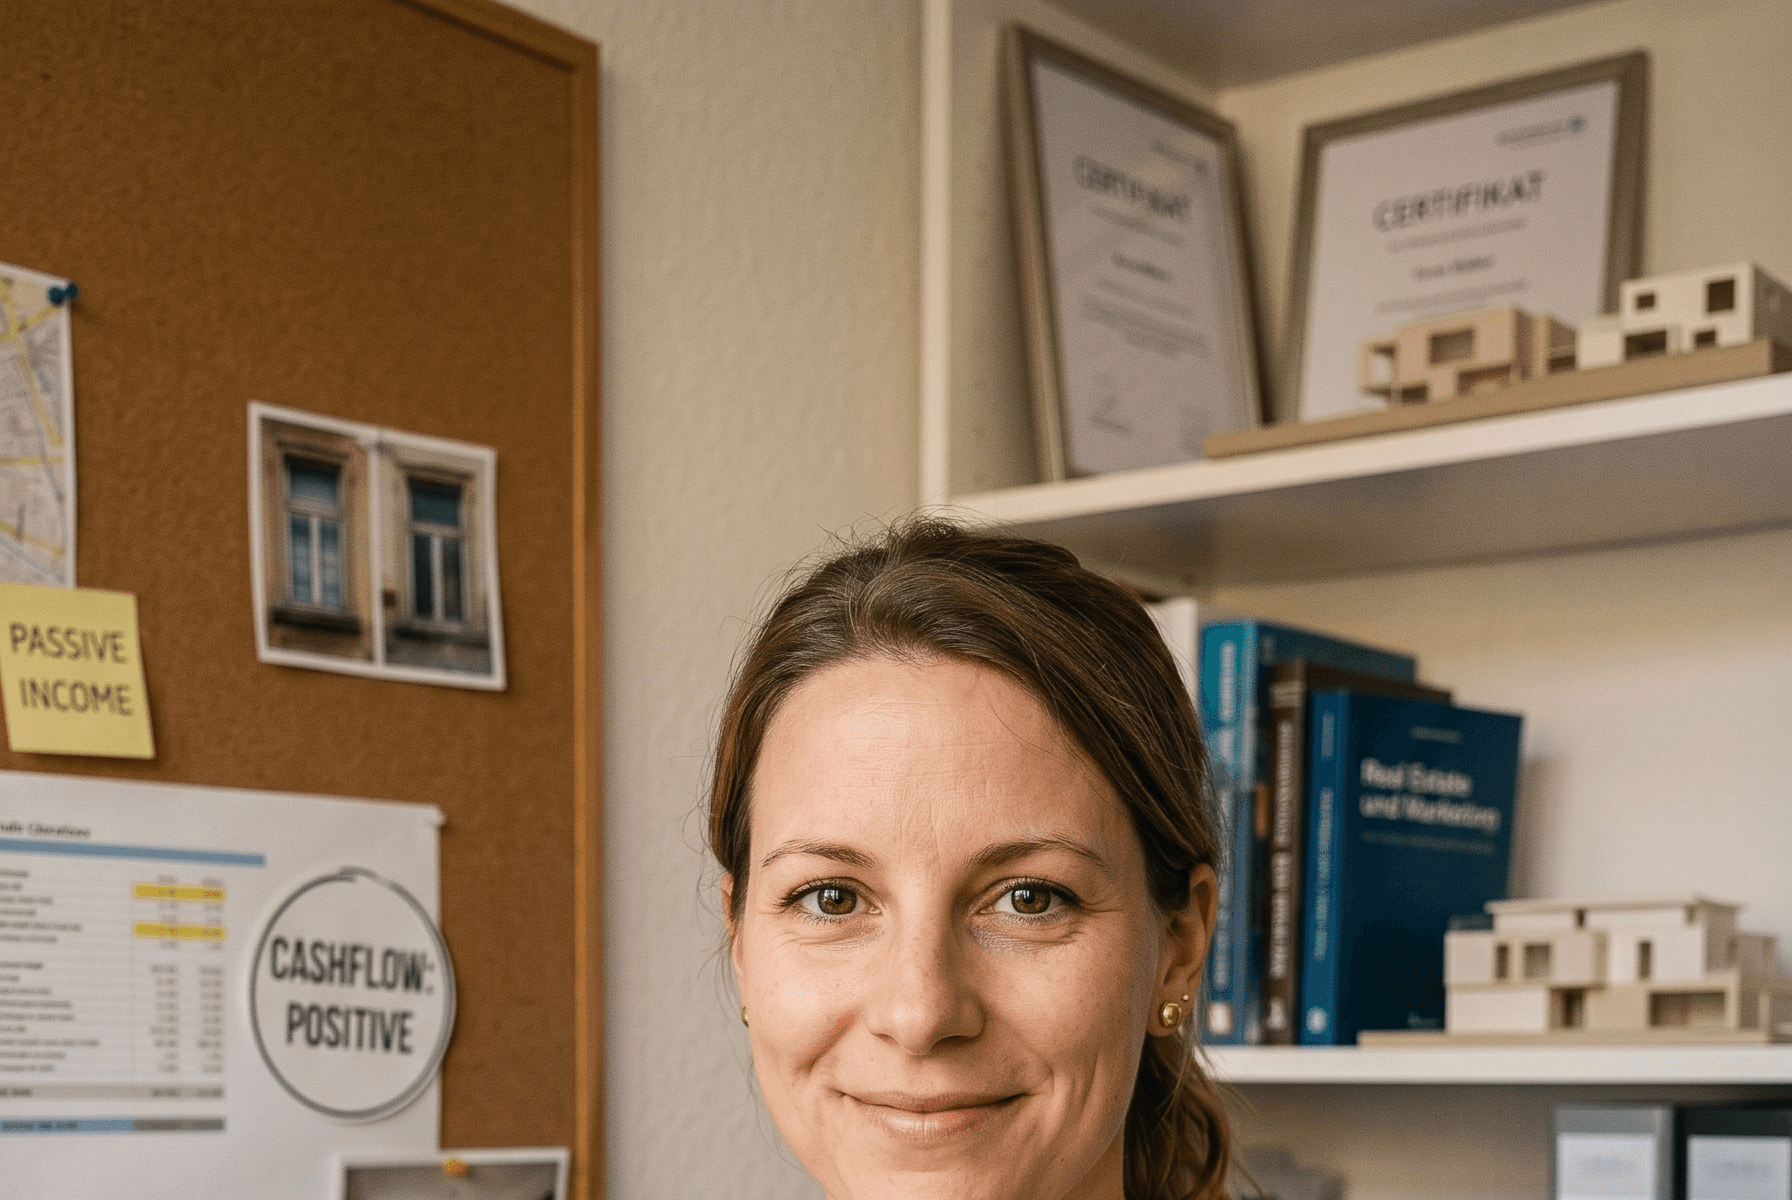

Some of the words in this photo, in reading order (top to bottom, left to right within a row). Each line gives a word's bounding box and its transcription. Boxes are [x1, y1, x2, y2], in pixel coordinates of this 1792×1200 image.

[9, 621, 128, 664] PASSIVE
[18, 678, 135, 717] INCOME
[269, 935, 435, 996] CASHFLOW:
[286, 1002, 414, 1055] POSITIVE
